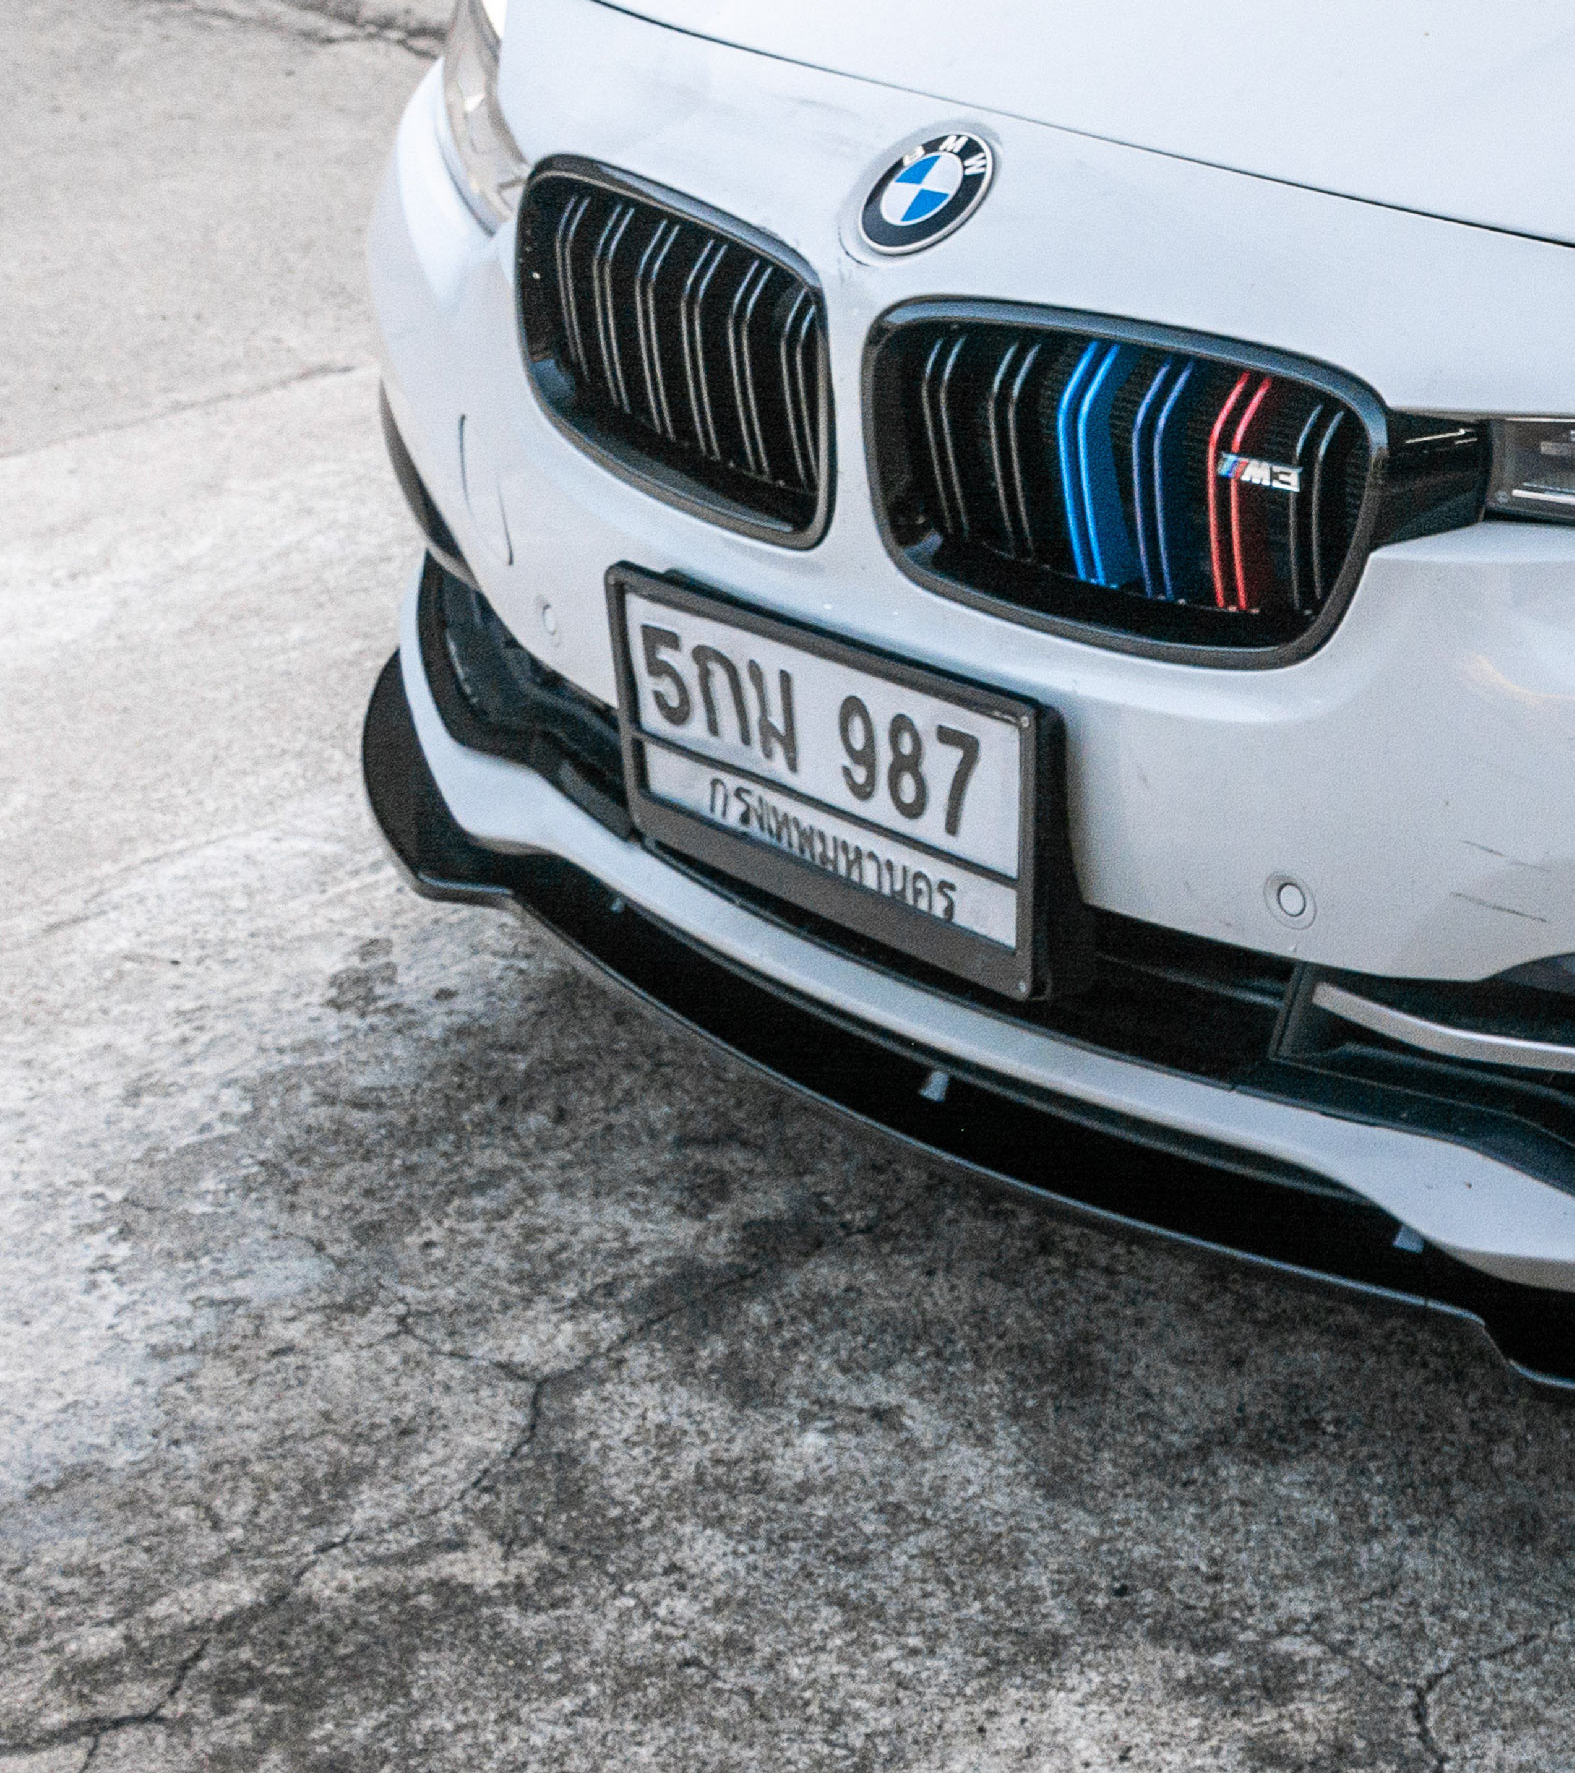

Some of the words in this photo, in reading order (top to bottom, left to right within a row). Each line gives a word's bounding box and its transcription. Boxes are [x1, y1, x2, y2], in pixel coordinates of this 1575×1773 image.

[903, 134, 986, 176] BMW
[1240, 457, 1301, 492] M3
[641, 624, 798, 773] 5กม
[838, 695, 981, 837] 987
[710, 778, 957, 921] กรงเทพมหานคร
